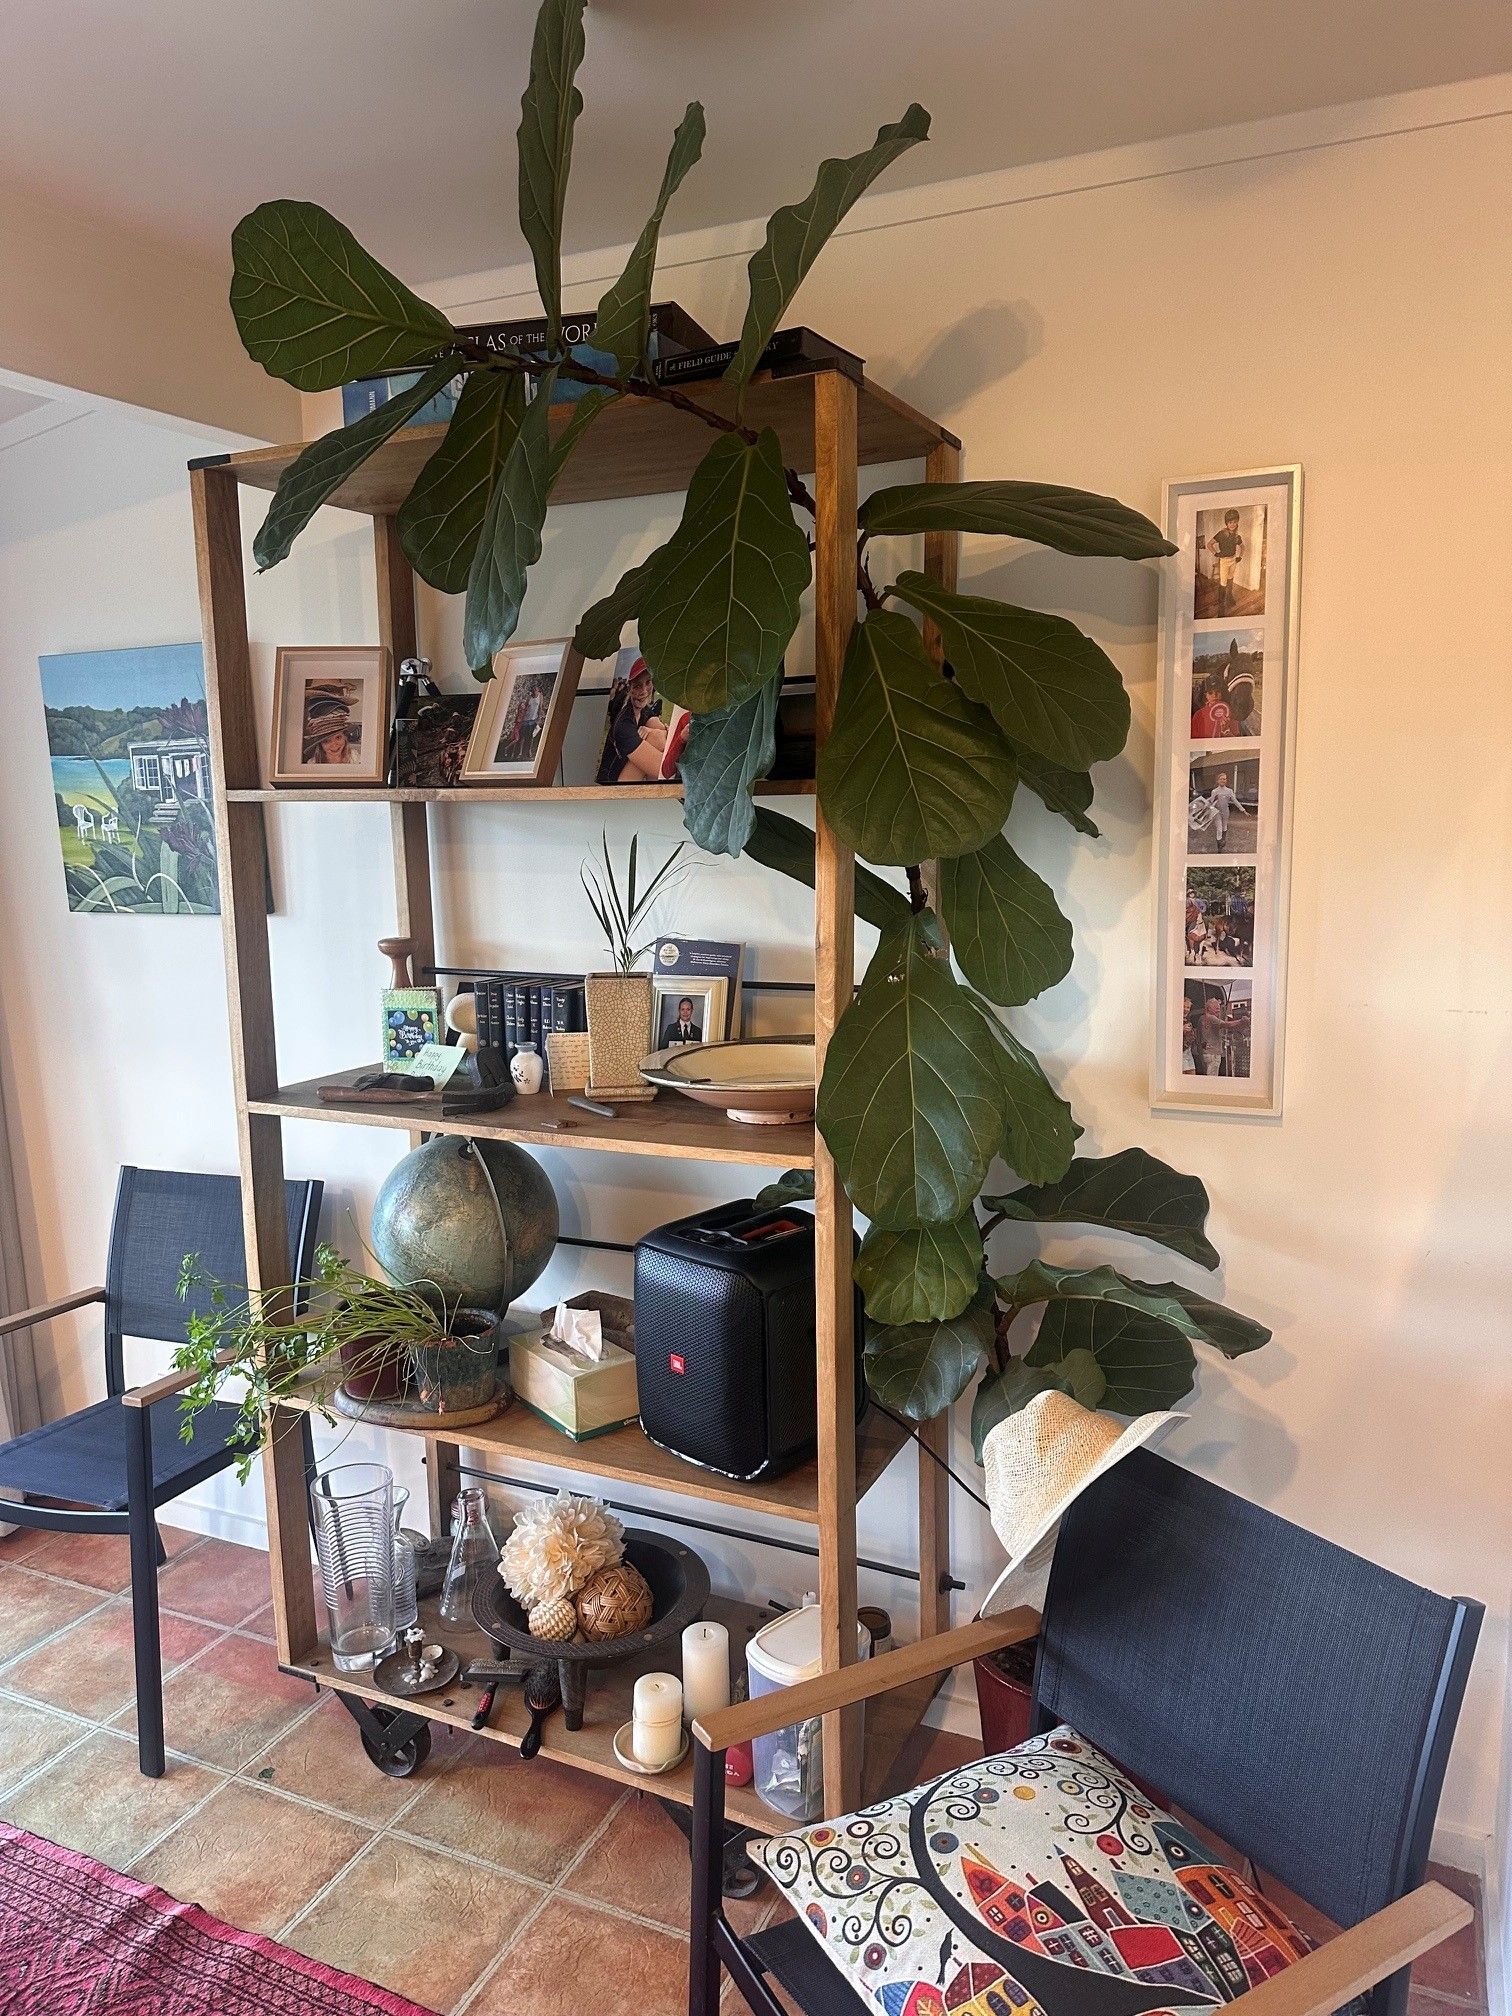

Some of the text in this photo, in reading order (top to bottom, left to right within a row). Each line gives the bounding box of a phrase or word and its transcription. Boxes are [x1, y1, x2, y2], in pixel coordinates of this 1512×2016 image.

[509, 334, 524, 346] OF
[526, 332, 545, 344] THE
[678, 357, 703, 370] FIELD
[704, 351, 732, 364] GUIDE
[423, 1048, 442, 1060] Happy
[415, 1059, 447, 1076] Birthday
